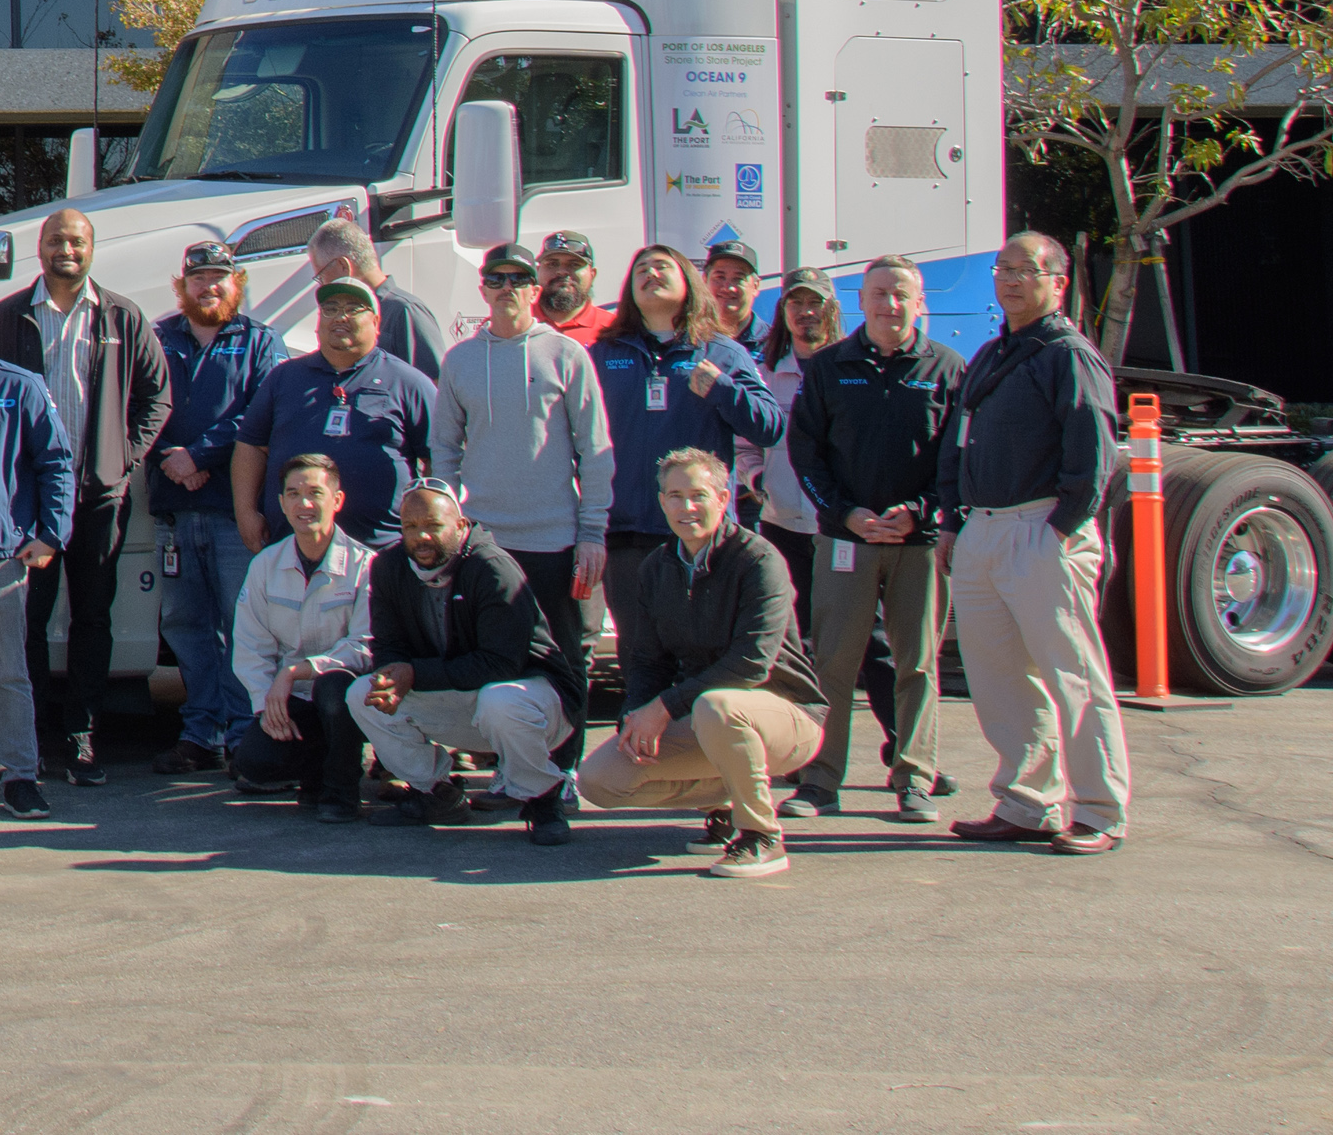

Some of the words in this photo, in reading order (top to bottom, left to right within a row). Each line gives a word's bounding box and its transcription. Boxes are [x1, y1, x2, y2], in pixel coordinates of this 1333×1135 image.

[662, 43, 688, 51] PORT
[691, 43, 704, 51] OF
[706, 43, 724, 51] LOS
[726, 44, 765, 53] ANGELES
[664, 55, 693, 64] Shore
[694, 56, 704, 64] to
[706, 56, 729, 64] Store
[731, 56, 762, 67] Project
[686, 70, 735, 83] OCEAN
[737, 71, 747, 83] 9
[685, 175, 701, 184] The
[702, 175, 721, 184] Port
[737, 199, 762, 208] AQMD
[139, 570, 155, 593] 9
